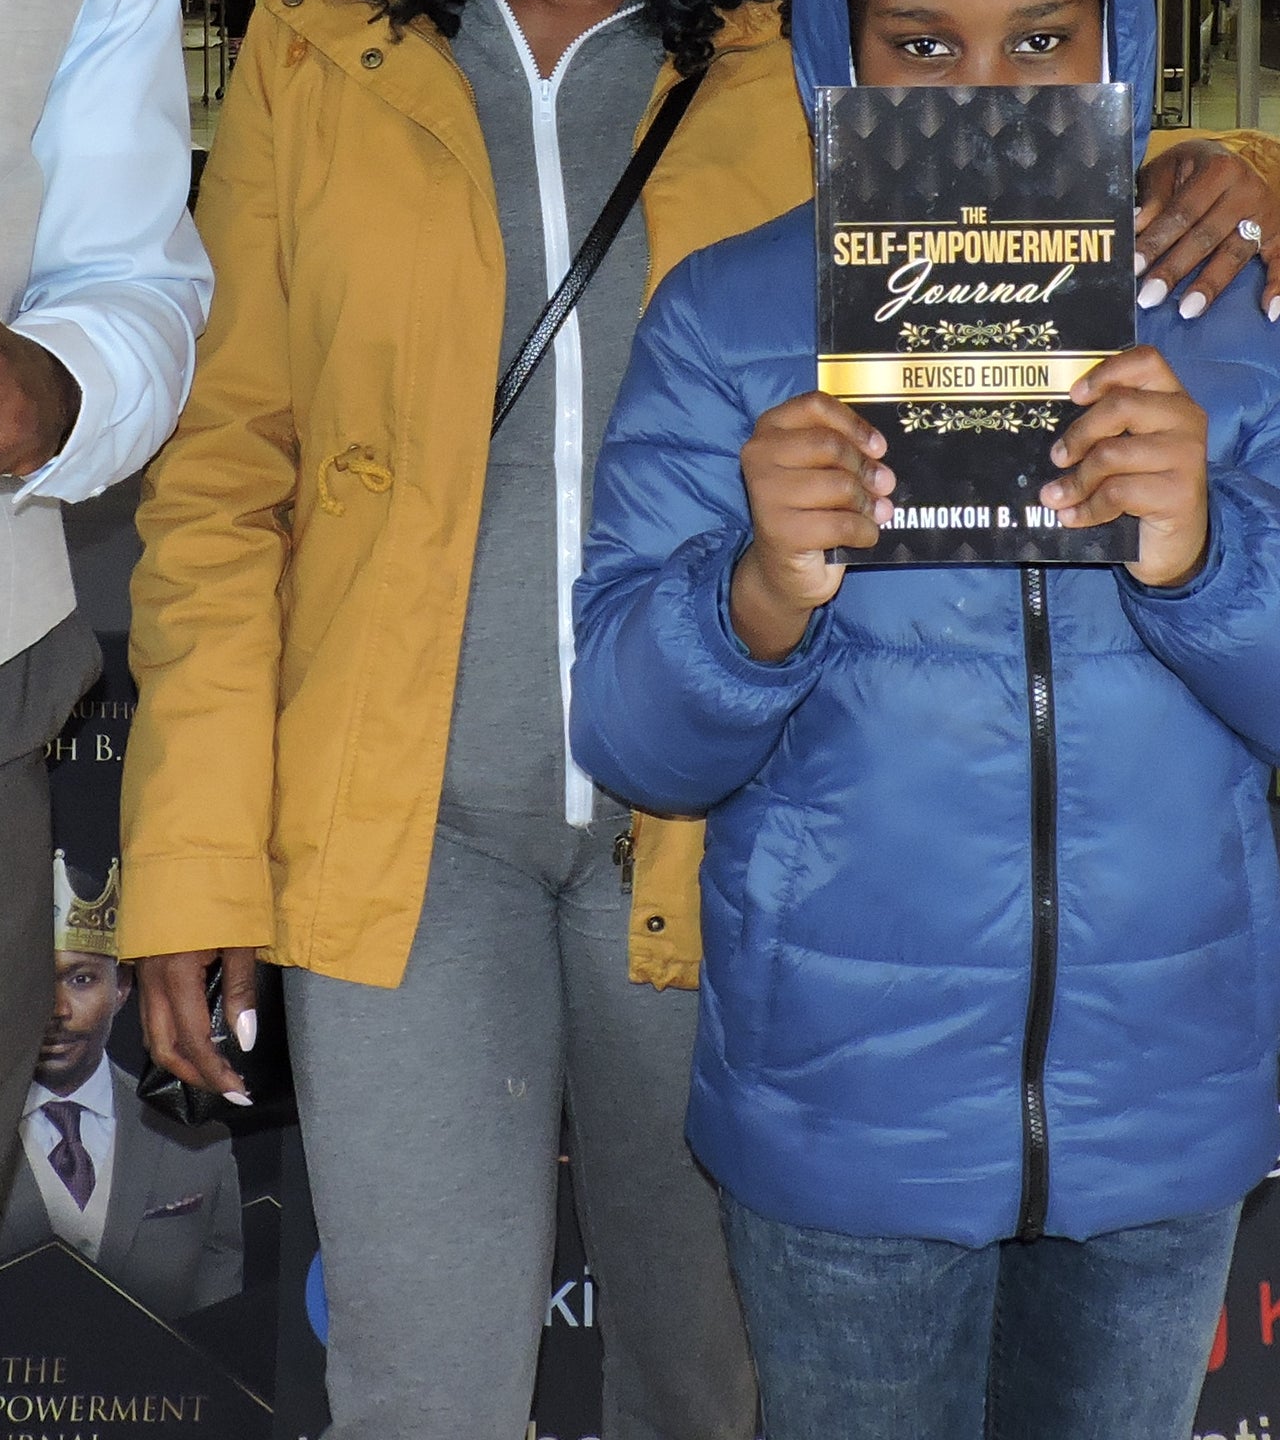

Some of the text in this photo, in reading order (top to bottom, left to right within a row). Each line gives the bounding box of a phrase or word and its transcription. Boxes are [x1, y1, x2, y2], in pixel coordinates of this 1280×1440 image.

[960, 206, 987, 224] THE
[834, 228, 1115, 266] SELF-EMPOWERMENT
[874, 257, 1075, 323] Journal
[902, 364, 1049, 389] REVISED EDITION
[997, 506, 1018, 528] B.
[2, 1356, 66, 1384] THE
